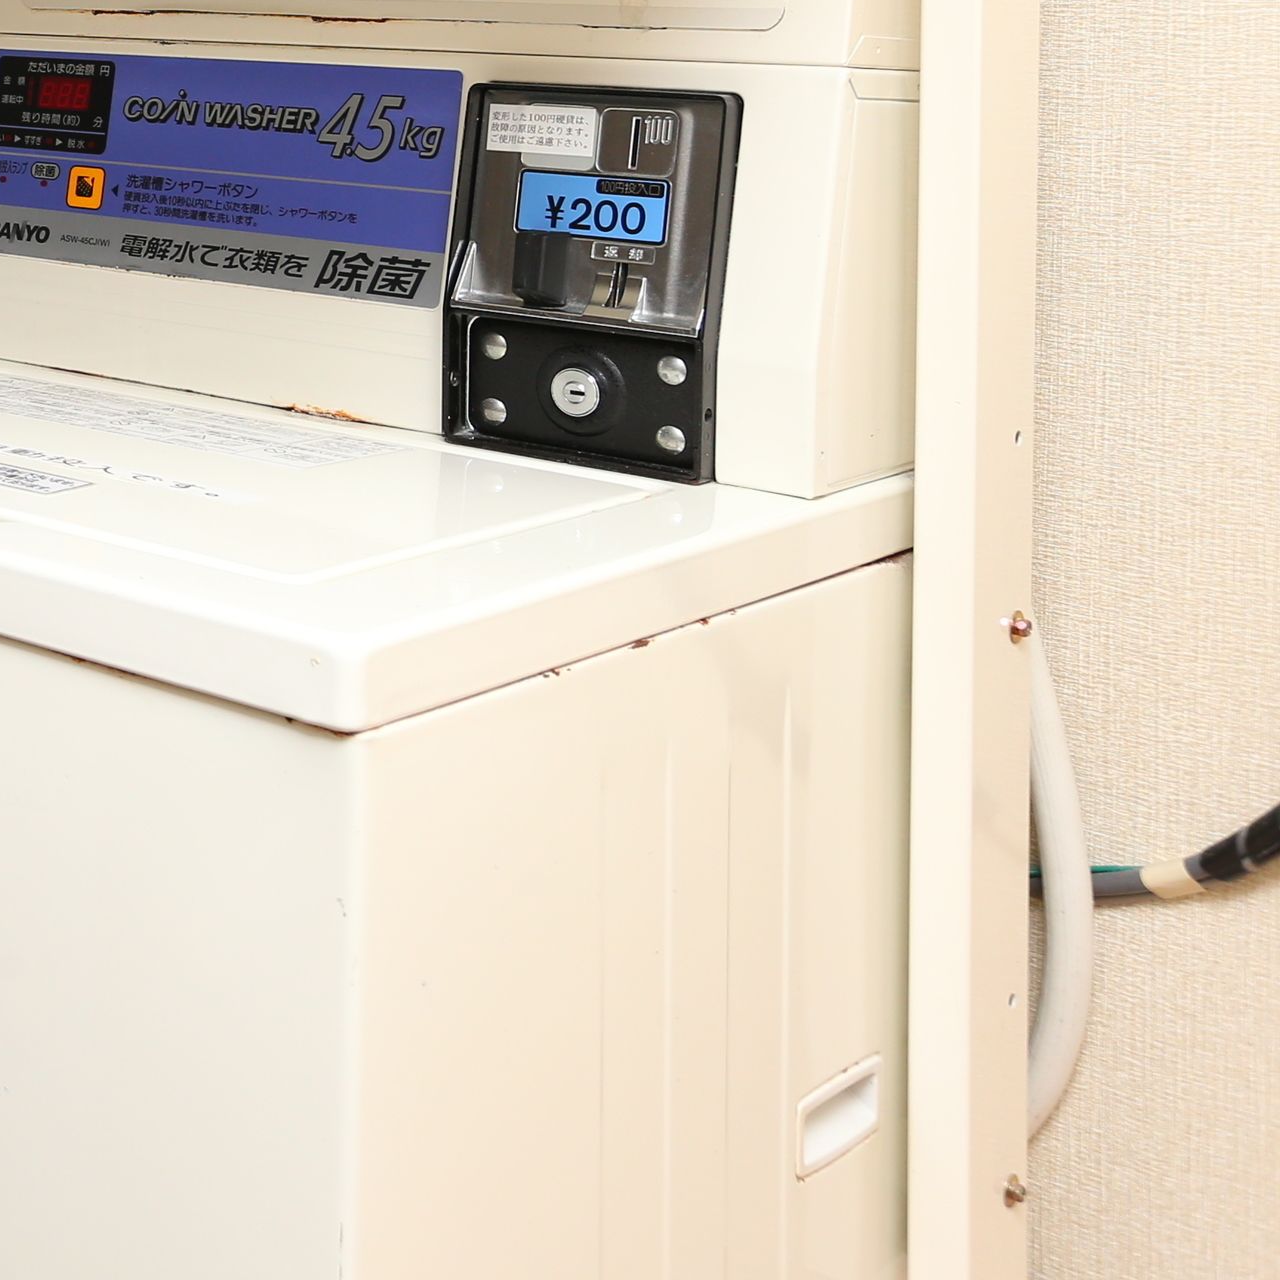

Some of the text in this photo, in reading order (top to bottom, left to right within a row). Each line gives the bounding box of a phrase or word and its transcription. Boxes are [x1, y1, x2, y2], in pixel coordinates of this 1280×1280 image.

[28, 62, 111, 77] ただいまの金額 円
[92, 116, 103, 128] 分
[204, 102, 320, 135] WASHER
[492, 111, 590, 126] 変形した100円硬貨は、
[491, 122, 589, 138] 故障の原因となります。
[644, 115, 674, 145] 100
[490, 134, 589, 150] ご使用はご遠慮下さい。
[34, 165, 56, 177] 除菌
[126, 174, 258, 199] 洗濯槽シャワーボタン
[600, 180, 662, 196] 100円投入口
[544, 195, 646, 235] ¥200
[120, 233, 431, 300] 電解水で衣類を 除菌
